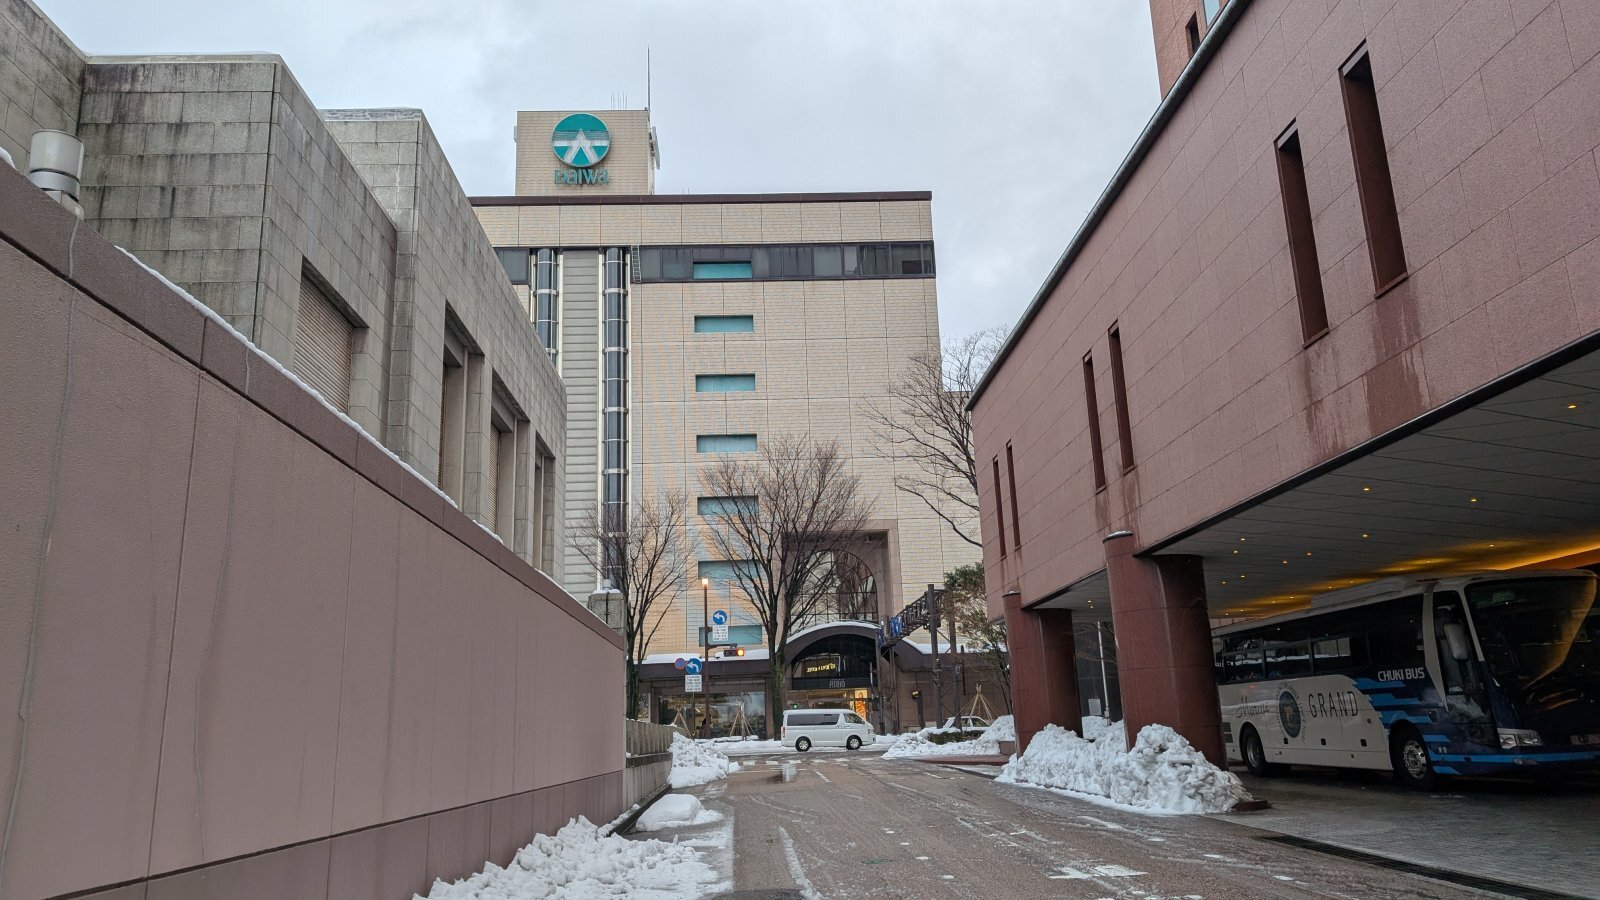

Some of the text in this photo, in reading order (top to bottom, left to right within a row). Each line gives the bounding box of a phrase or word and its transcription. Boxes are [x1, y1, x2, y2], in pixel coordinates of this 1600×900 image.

[1377, 667, 1425, 682] CHUKI BUS
[1308, 691, 1358, 718] GRAND
